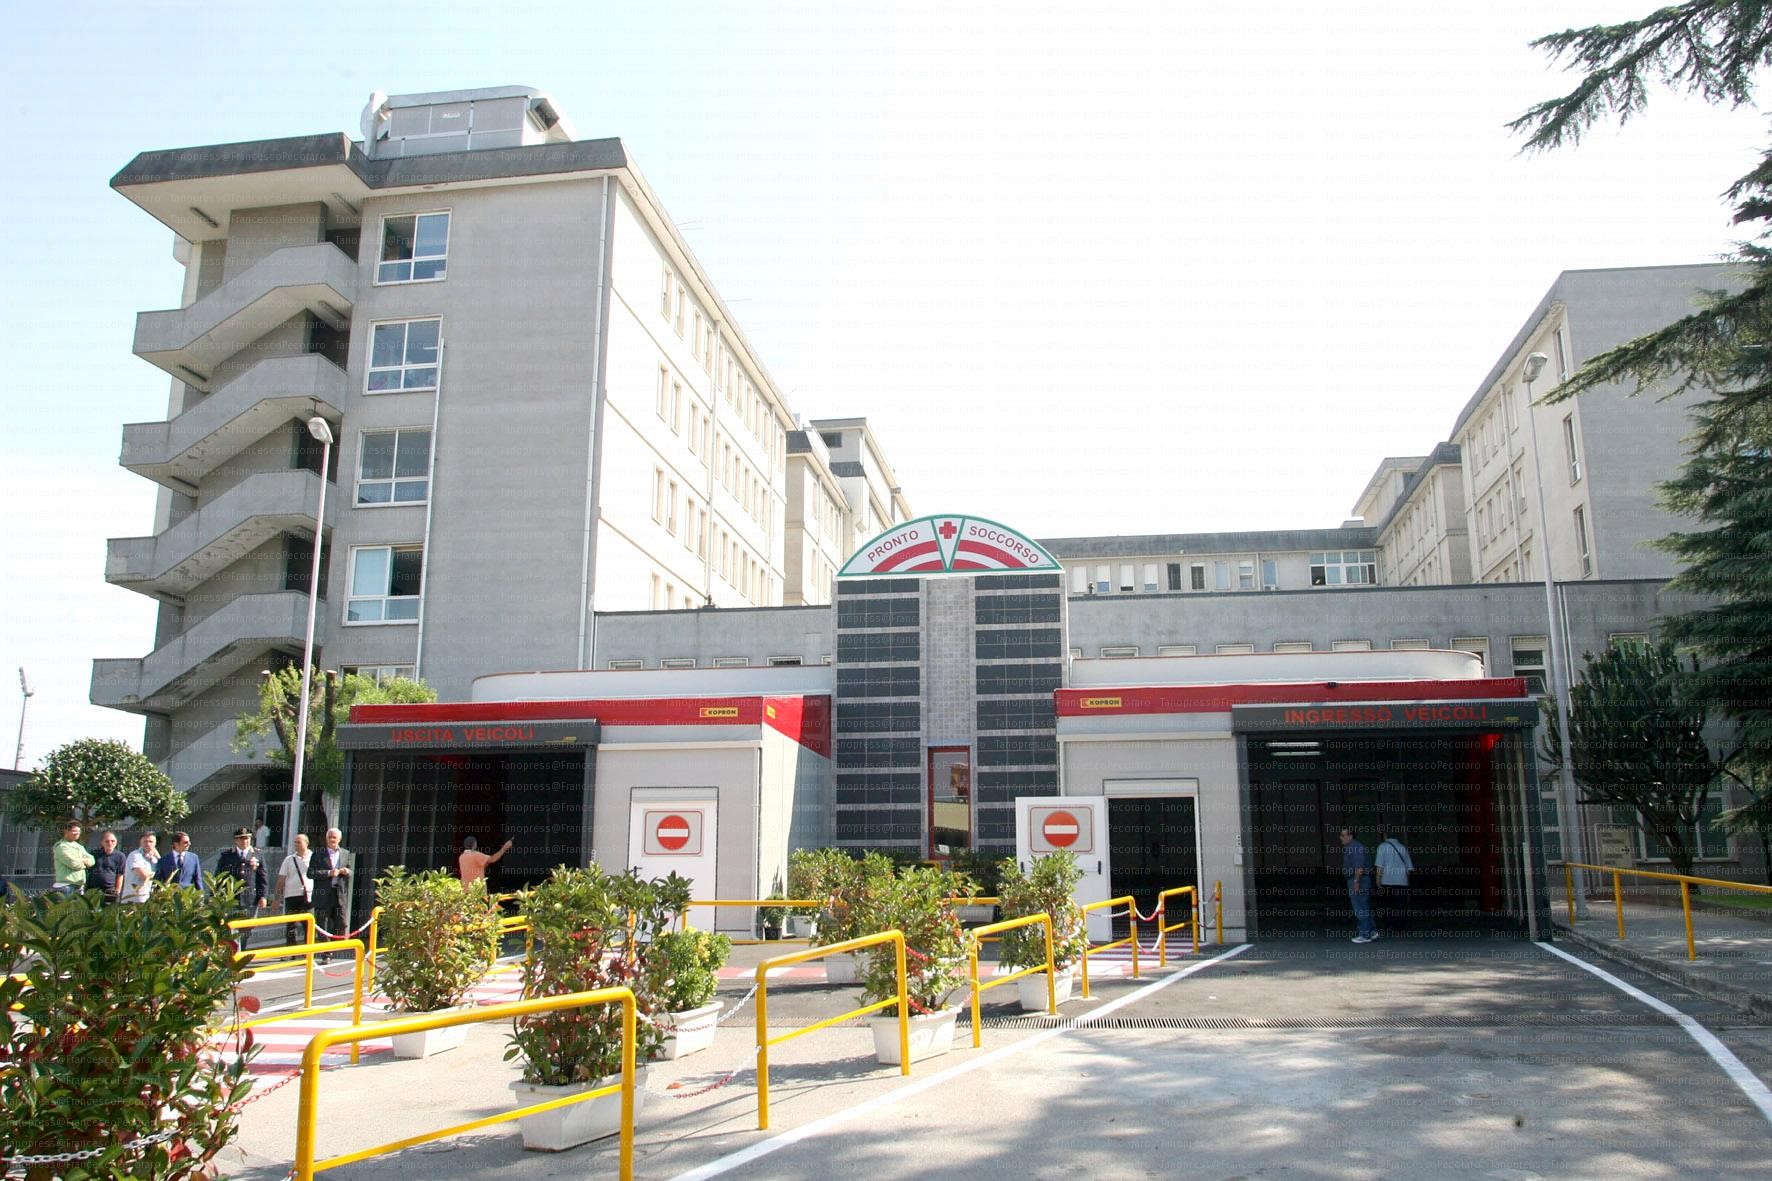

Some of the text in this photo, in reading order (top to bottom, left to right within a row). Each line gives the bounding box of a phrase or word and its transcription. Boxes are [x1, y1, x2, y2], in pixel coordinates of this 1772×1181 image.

[867, 525, 1040, 565] PRONTO SOCCORSO
[1283, 706, 1392, 722] INGRESSO
[1404, 705, 1488, 721] VEICOLI
[391, 728, 454, 742] USCITA
[464, 727, 534, 741] VEICOLI
